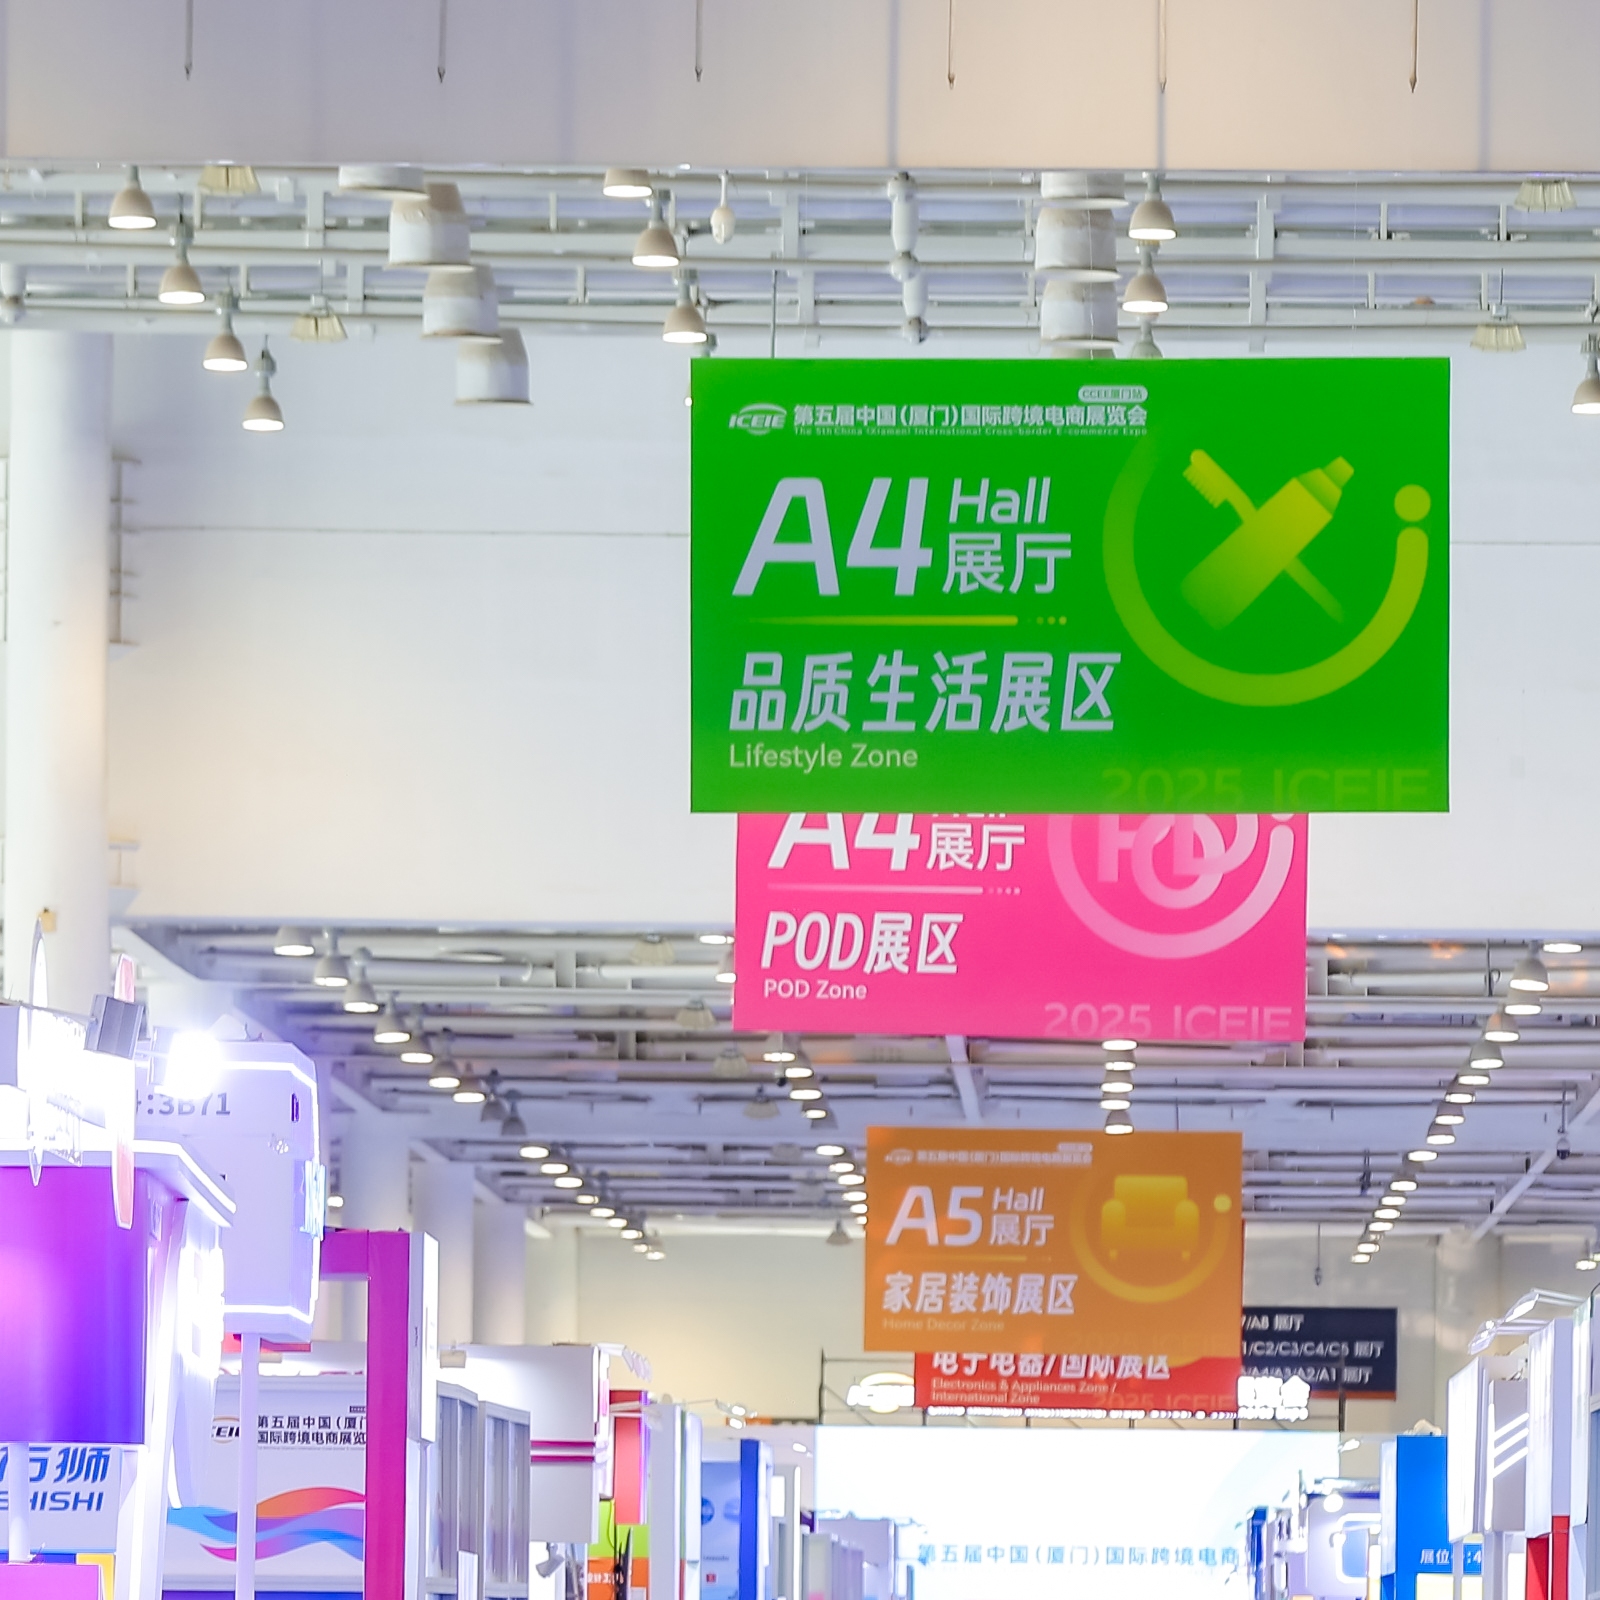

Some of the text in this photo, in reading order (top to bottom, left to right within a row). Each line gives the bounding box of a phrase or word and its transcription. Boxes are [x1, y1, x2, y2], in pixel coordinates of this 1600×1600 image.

[728, 413, 787, 429] ICEIE
[794, 404, 1148, 426] 第五届中国(厦门)国际跨境电商展览会
[795, 426, 811, 436] The
[816, 426, 832, 436] 5th
[834, 426, 862, 436] China
[914, 426, 981, 436] International
[1124, 426, 1148, 436] Expo
[731, 477, 1053, 597] A4 Hall
[942, 533, 1073, 597] 展厅
[728, 651, 1122, 733] 品质生活展区
[729, 743, 918, 772] Lifestyle Zone
[926, 824, 1027, 872] 展厅
[761, 912, 964, 976] POD展区
[764, 979, 867, 999] POD Zone
[1043, 1003, 1293, 1041] 2025 ICEIE
[885, 1185, 1045, 1246] A5 Hall
[989, 1215, 1055, 1247] 展厅
[883, 1271, 1078, 1315] 家居装饰展区
[883, 1318, 1004, 1333] Home Decor Zone
[932, 1379, 997, 1391] Electronics
[1012, 1380, 1075, 1395] Appliances
[1079, 1381, 1108, 1394] Zone
[932, 1392, 1040, 1405] International Zone
